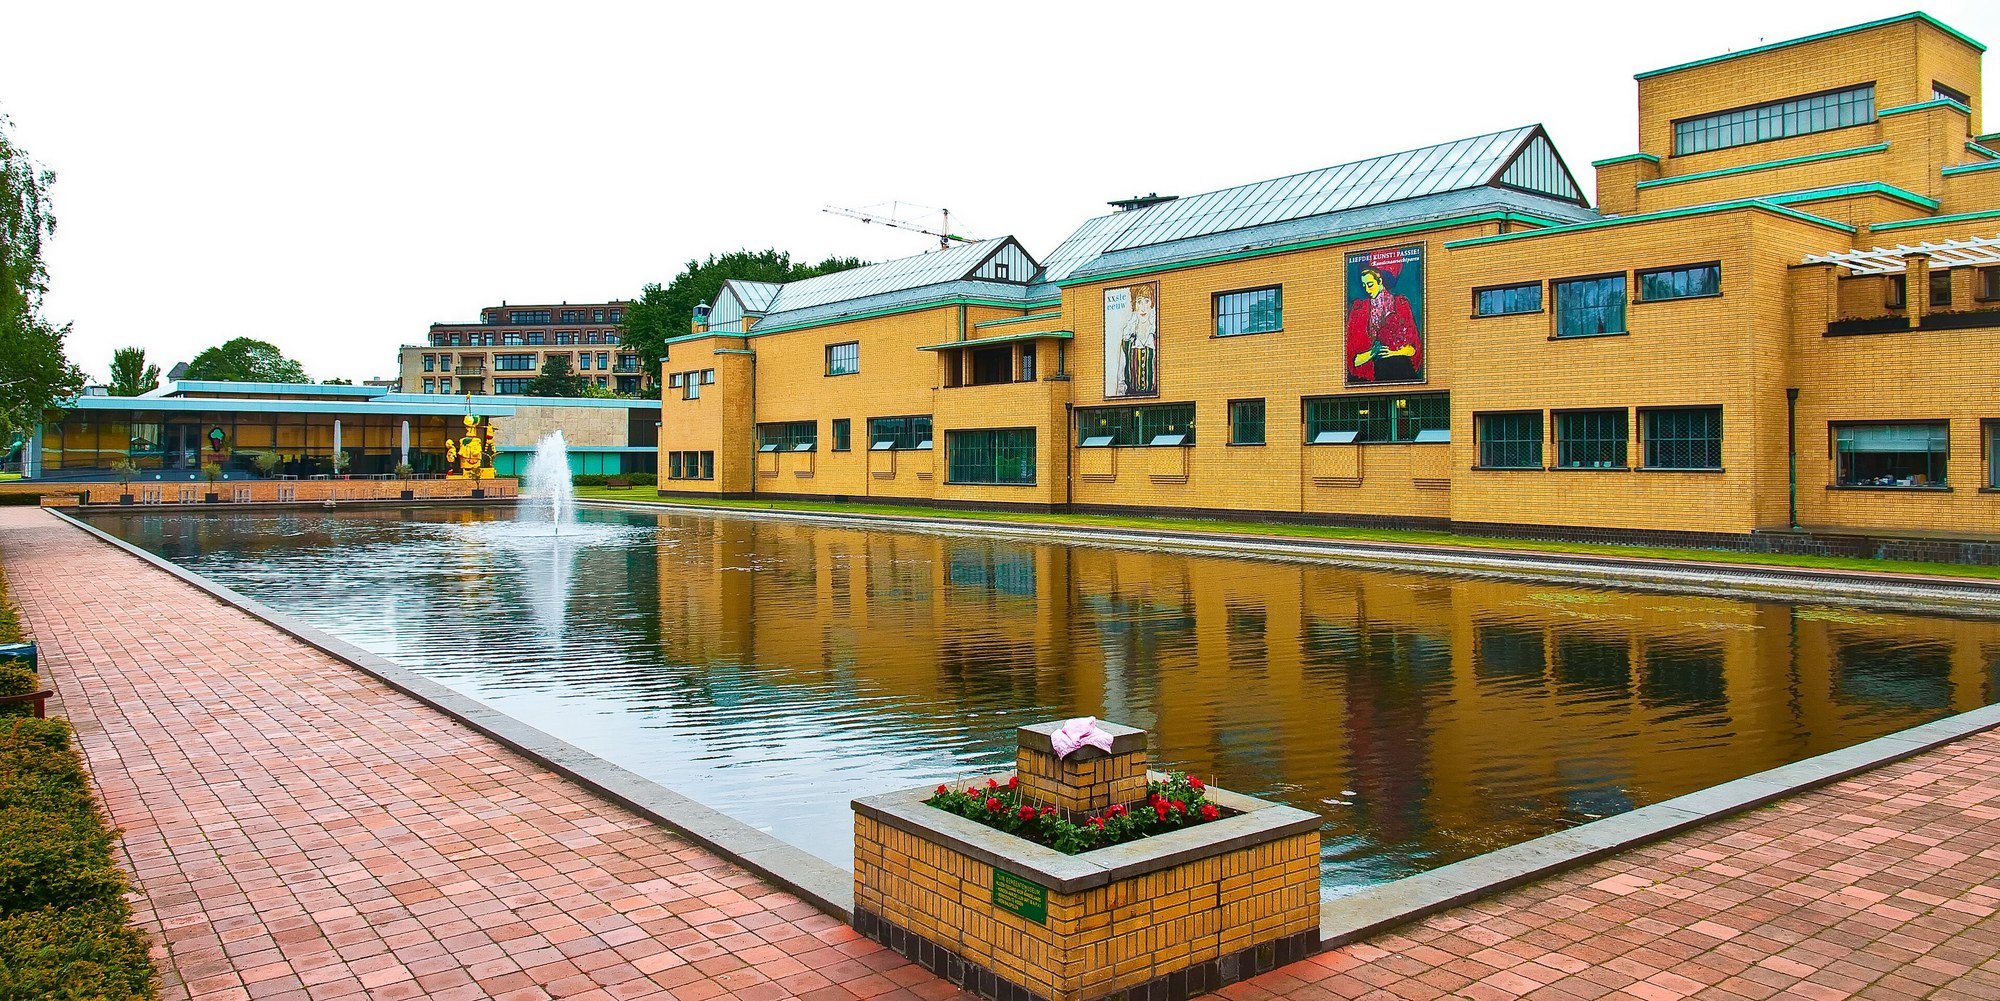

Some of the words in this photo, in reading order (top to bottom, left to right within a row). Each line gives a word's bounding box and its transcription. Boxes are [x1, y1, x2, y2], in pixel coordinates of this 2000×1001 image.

[1373, 252, 1396, 260] KUNST!
[1396, 249, 1420, 257] PASSIE!
[1107, 302, 1126, 311] eeuw
